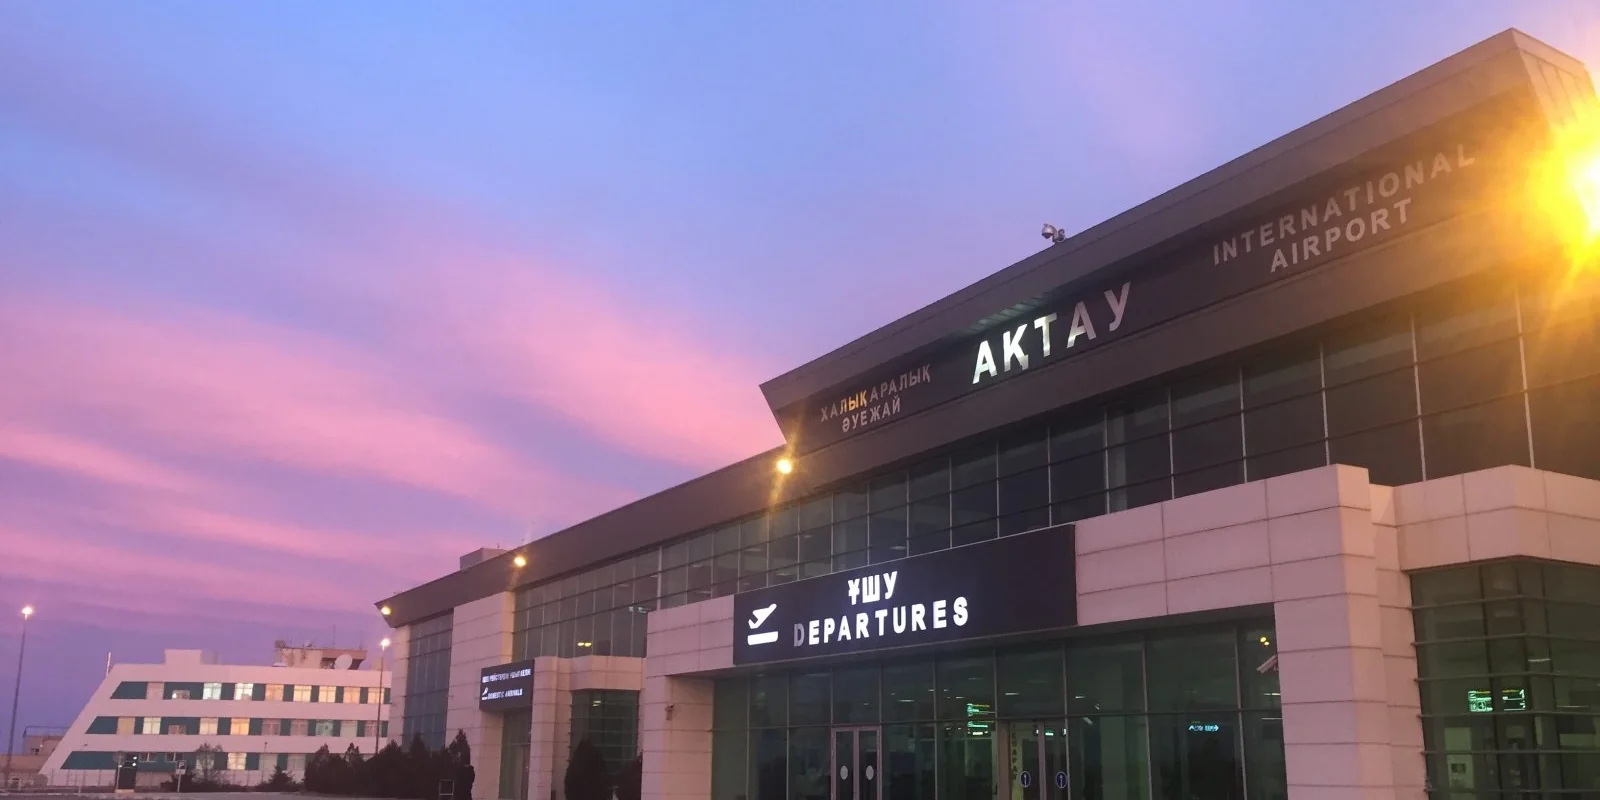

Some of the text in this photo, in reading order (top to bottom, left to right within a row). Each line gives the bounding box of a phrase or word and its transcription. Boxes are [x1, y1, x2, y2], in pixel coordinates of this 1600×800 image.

[1213, 143, 1476, 266] INTERNATIONAL
[1269, 197, 1412, 272] AIRPORT
[972, 281, 1132, 385] АҚТАУ
[820, 363, 931, 423] ХАЛЫҚАРАЛЫҚ
[842, 395, 901, 433] ӘУЕЖАЙ
[793, 596, 969, 647] DEPARTURES
